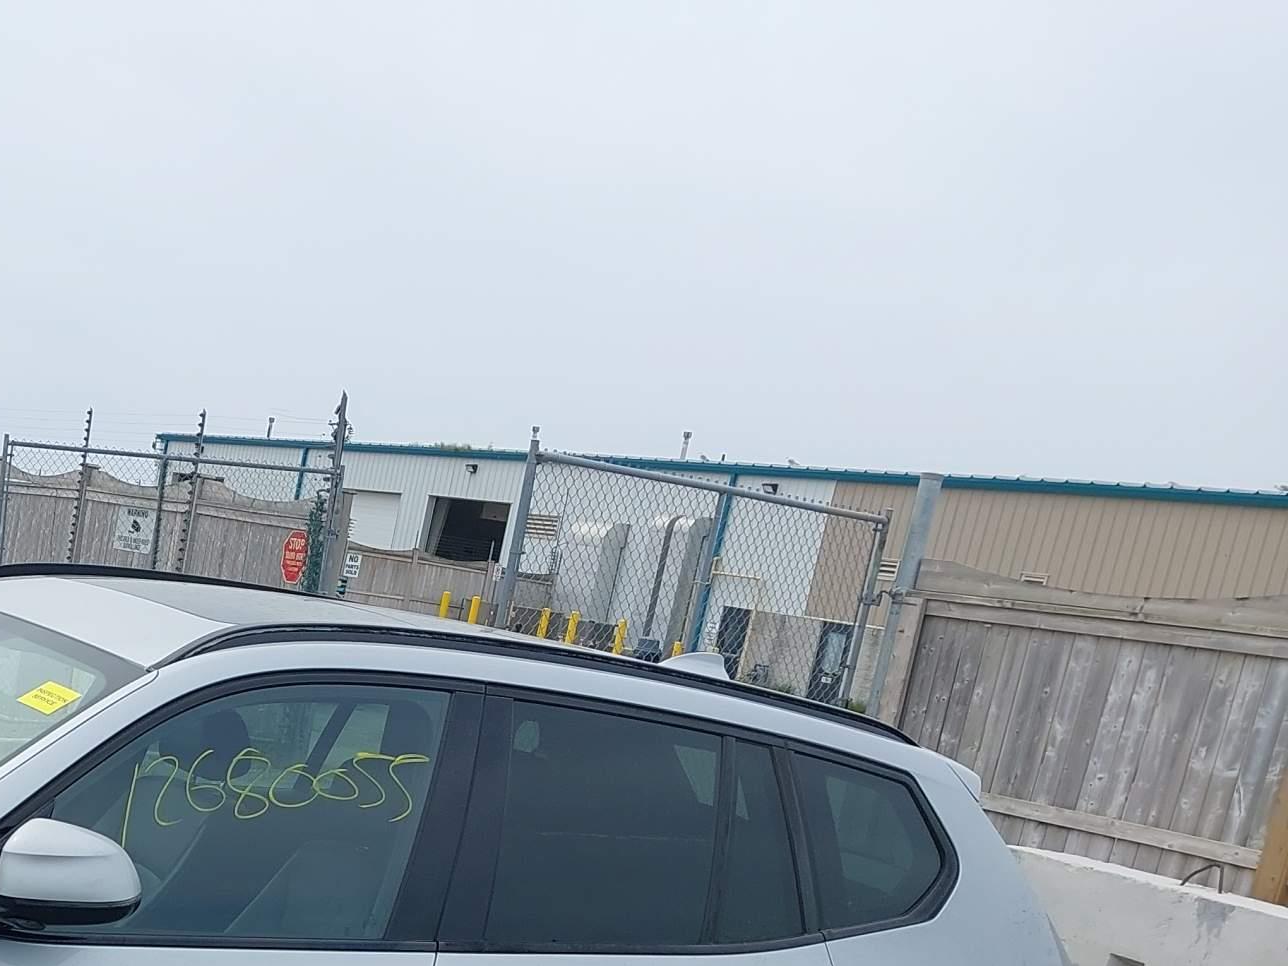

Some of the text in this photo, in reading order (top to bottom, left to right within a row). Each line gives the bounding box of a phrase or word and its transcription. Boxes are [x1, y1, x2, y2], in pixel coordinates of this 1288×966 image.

[289, 537, 306, 550] STOP
[348, 555, 359, 563] NO
[121, 746, 430, 848] 12680055
